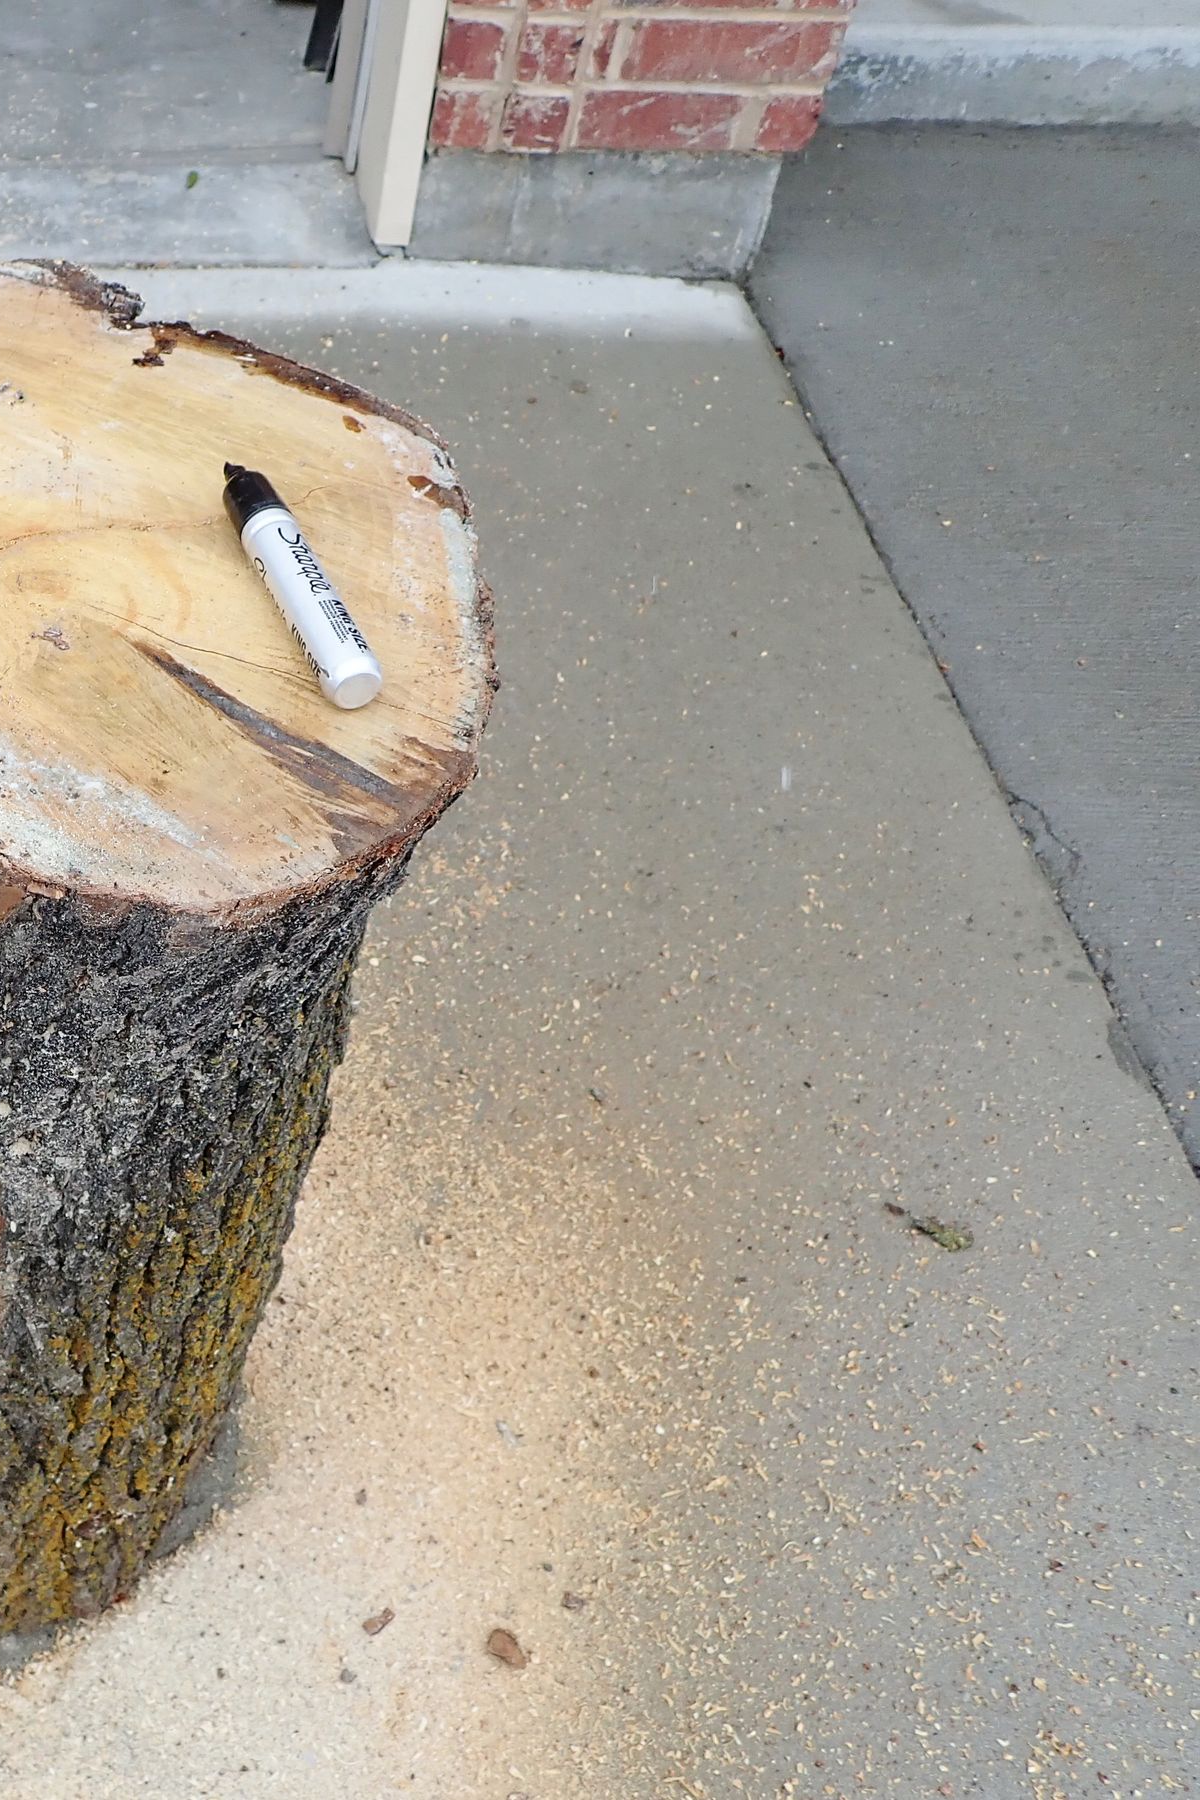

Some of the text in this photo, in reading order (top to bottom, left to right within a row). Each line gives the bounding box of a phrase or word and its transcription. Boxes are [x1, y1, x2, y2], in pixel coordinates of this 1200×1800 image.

[277, 528, 331, 594] Sharpie
[332, 599, 369, 650] KING SIZE
